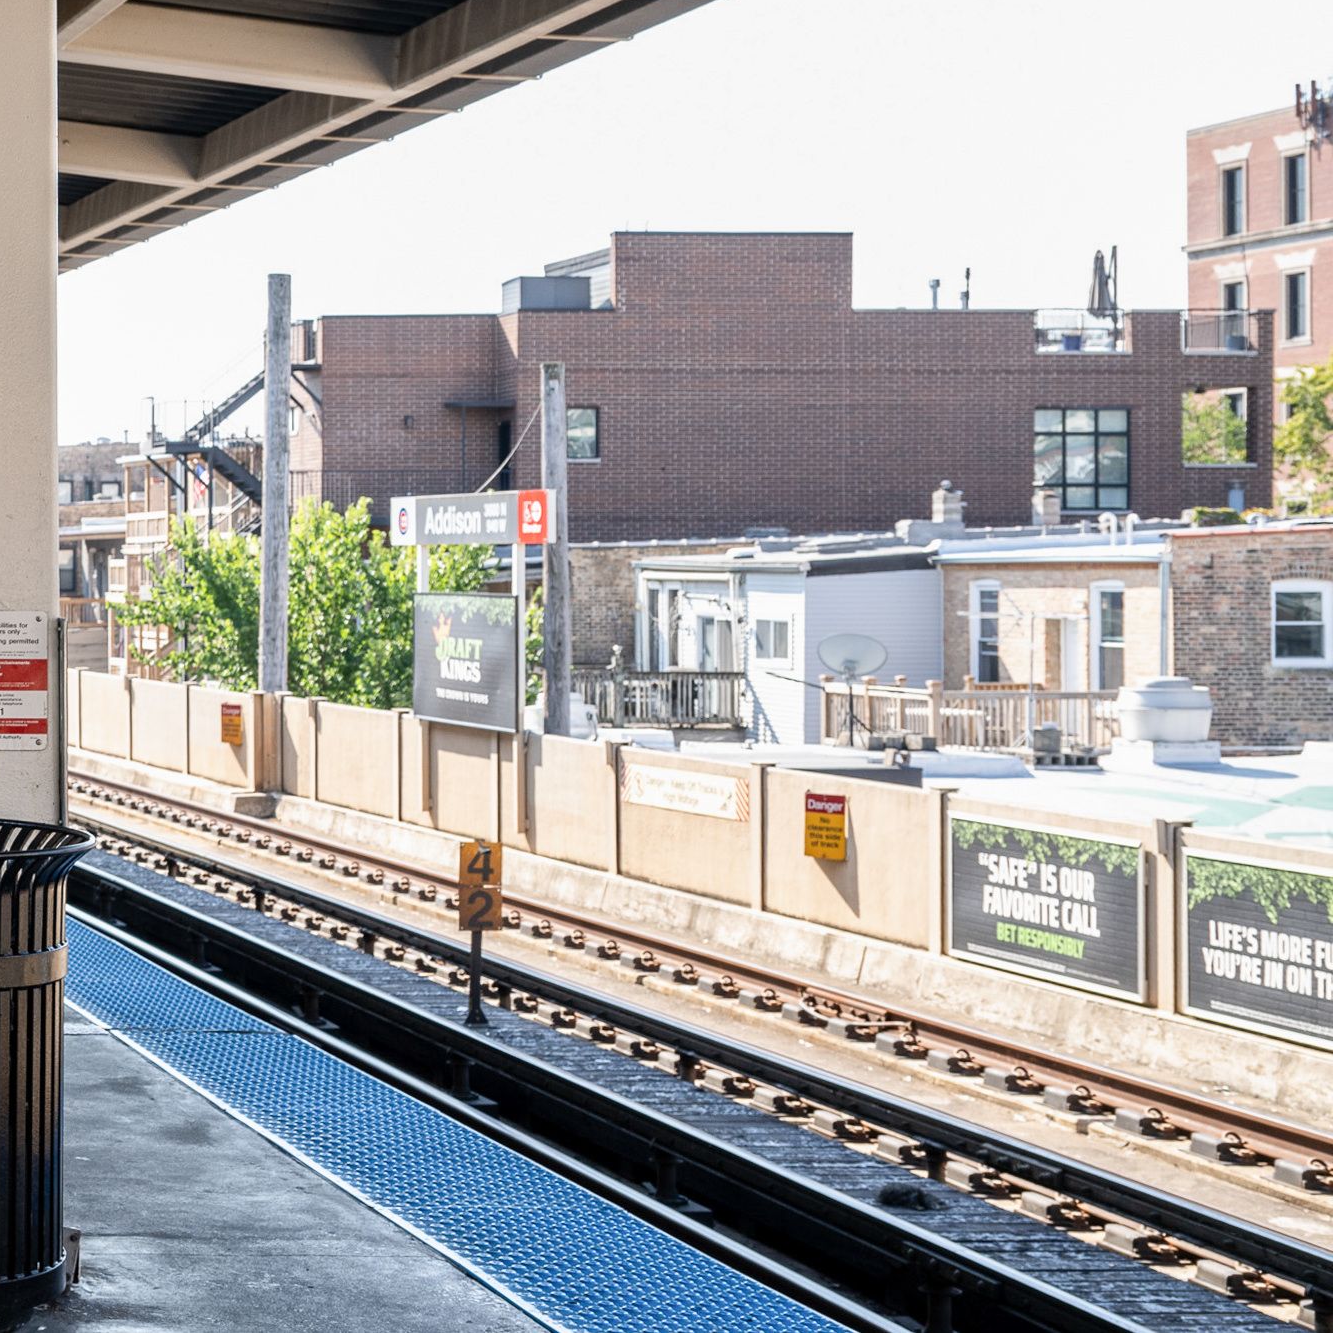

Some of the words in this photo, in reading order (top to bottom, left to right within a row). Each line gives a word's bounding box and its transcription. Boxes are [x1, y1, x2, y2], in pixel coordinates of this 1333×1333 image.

[424, 506, 482, 535] Addison
[440, 656, 481, 683] KINGS
[807, 798, 844, 814] Danger
[467, 847, 494, 882] 4
[1040, 862, 1058, 895] IS
[1059, 866, 1096, 903] OUR
[468, 890, 494, 928] 2
[982, 884, 1060, 929] FAVORITE
[1061, 900, 1101, 938] CALL
[996, 921, 1018, 944] BET
[1017, 925, 1085, 960] RESPONSIBLY
[1209, 919, 1259, 955] LIFE'S
[1260, 929, 1313, 966] MORE
[1201, 946, 1263, 986] YOU'RE
[1264, 960, 1285, 990] IN
[1286, 965, 1313, 997] ON
